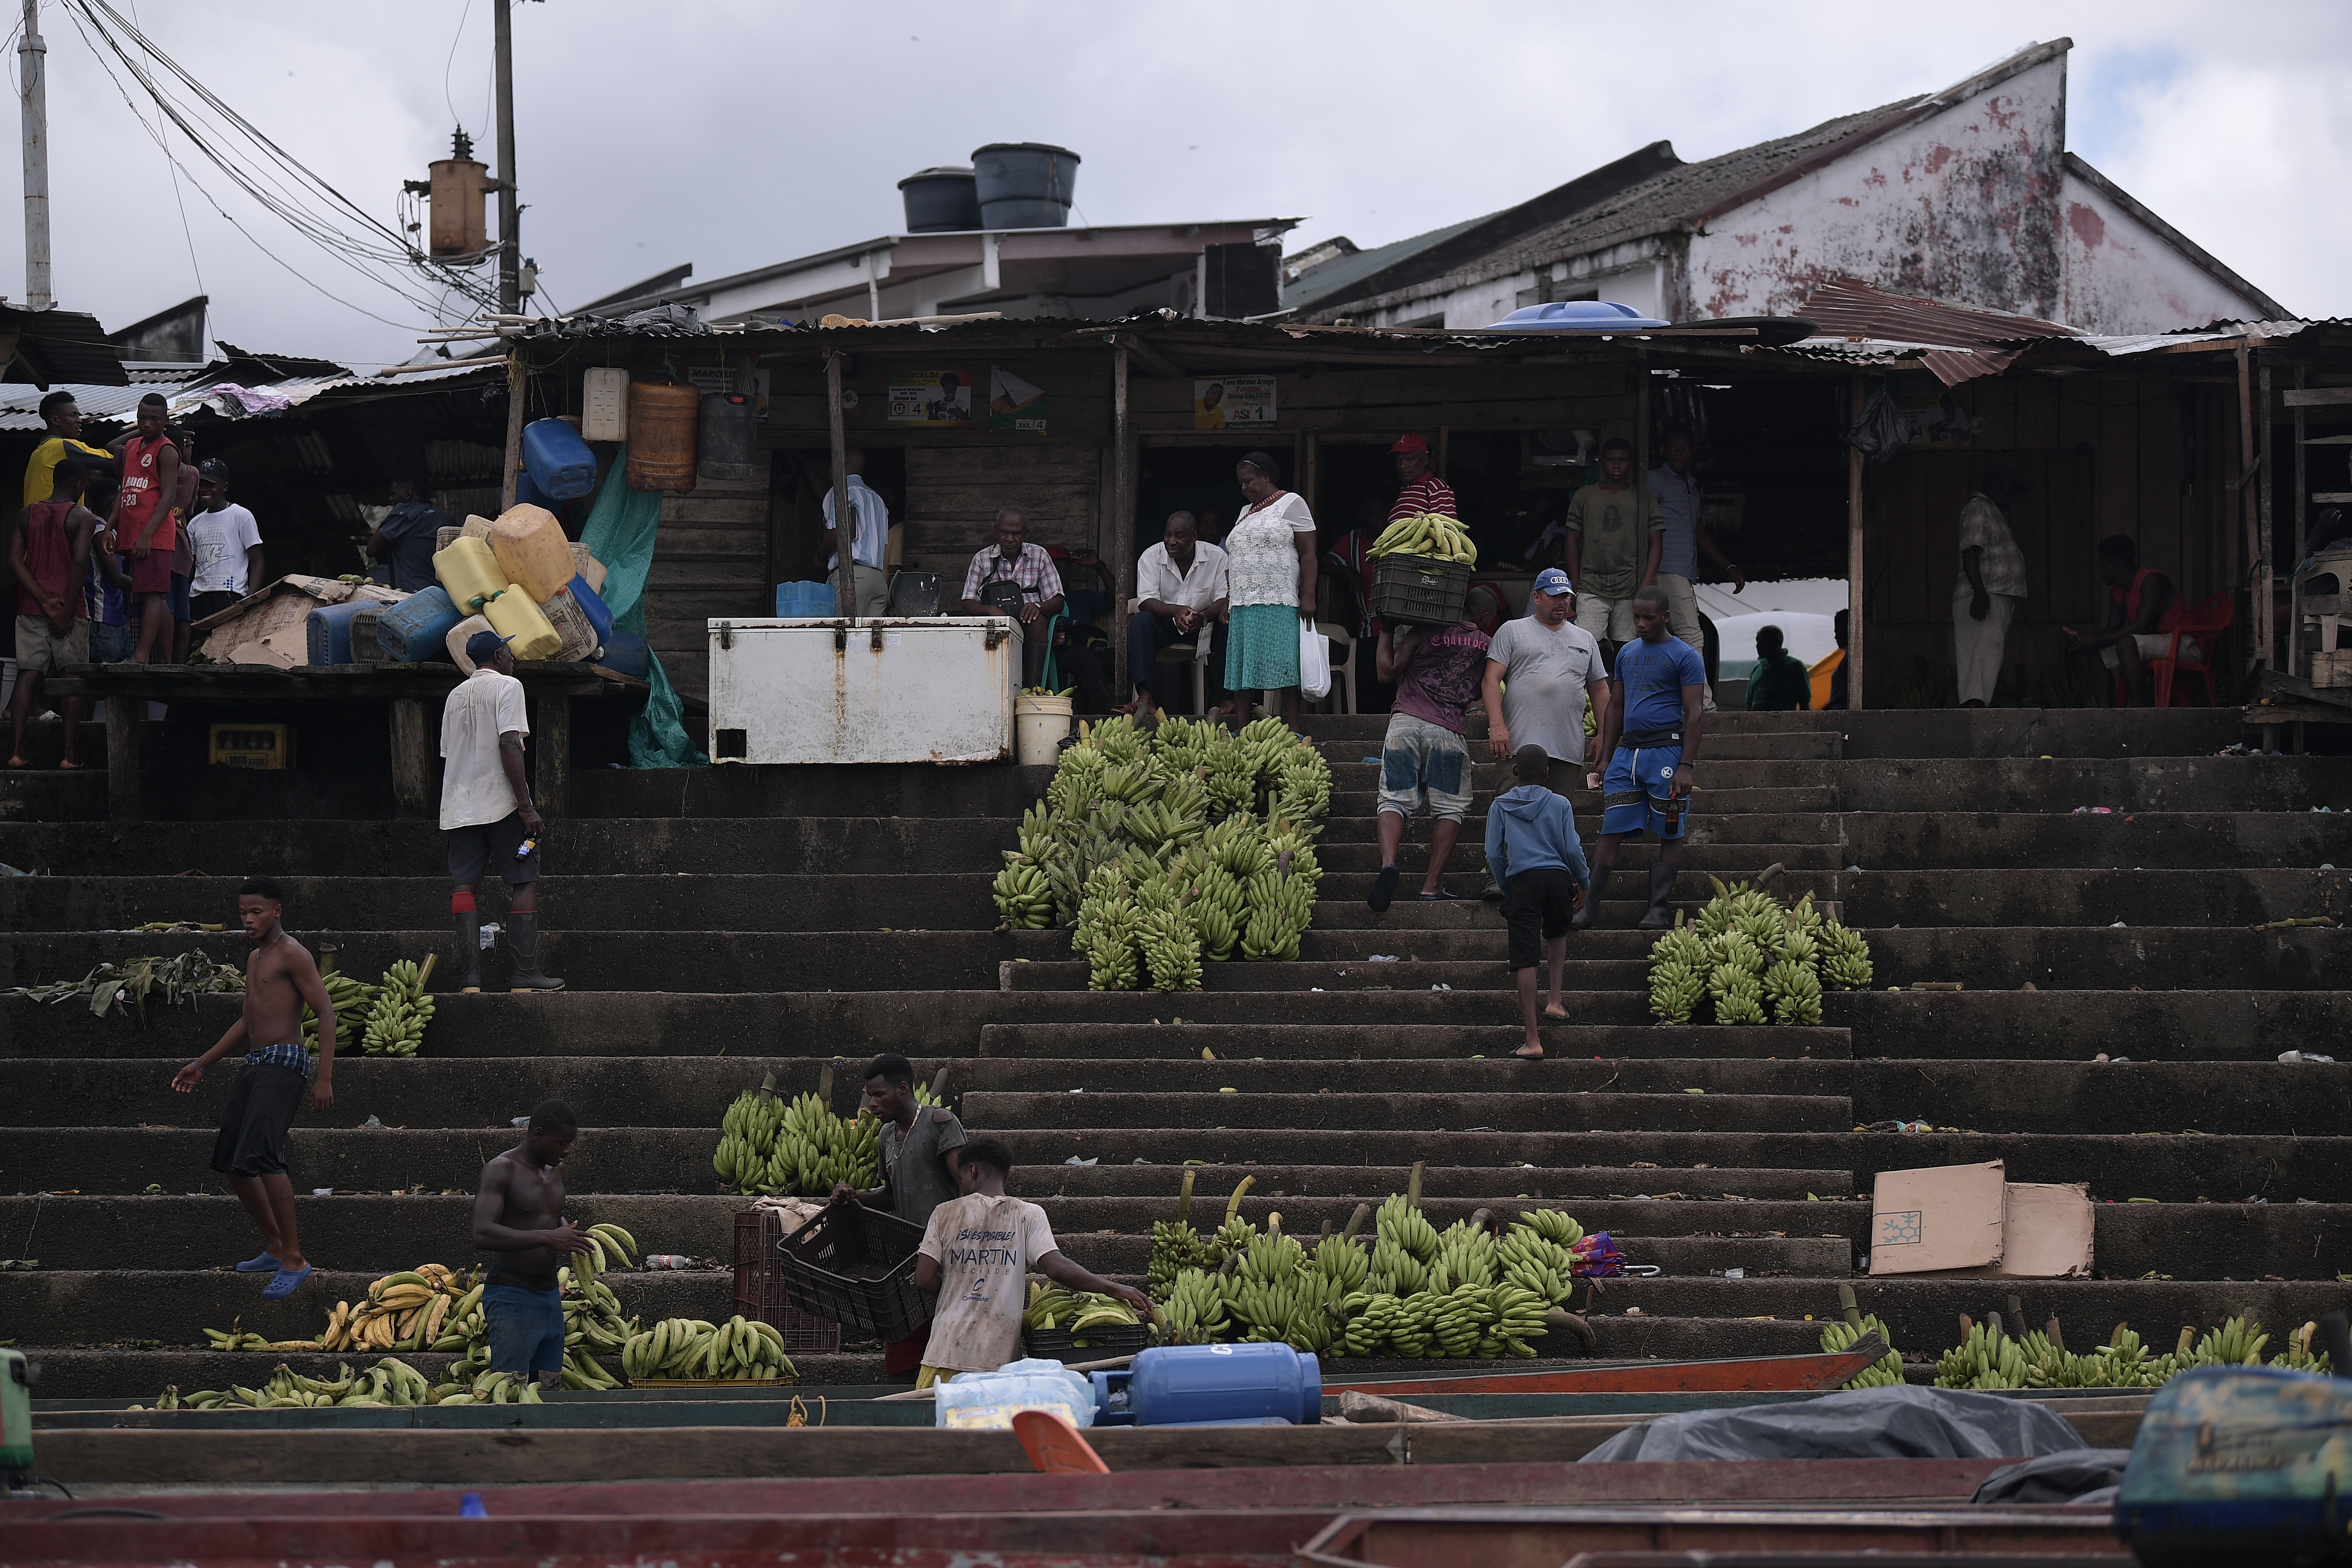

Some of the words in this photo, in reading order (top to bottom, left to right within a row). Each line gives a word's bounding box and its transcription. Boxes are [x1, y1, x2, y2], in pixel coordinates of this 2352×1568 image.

[913, 403, 921, 414] 4
[1255, 406, 1263, 419] 1
[1037, 421, 1043, 429] 4
[1915, 426, 1923, 437] 4
[197, 544, 225, 562] NIKE
[1634, 655, 1639, 666] &
[972, 1231, 981, 1241] ES
[981, 1231, 1015, 1242] POSIBLE!
[950, 1245, 1016, 1266] MARTÍN
